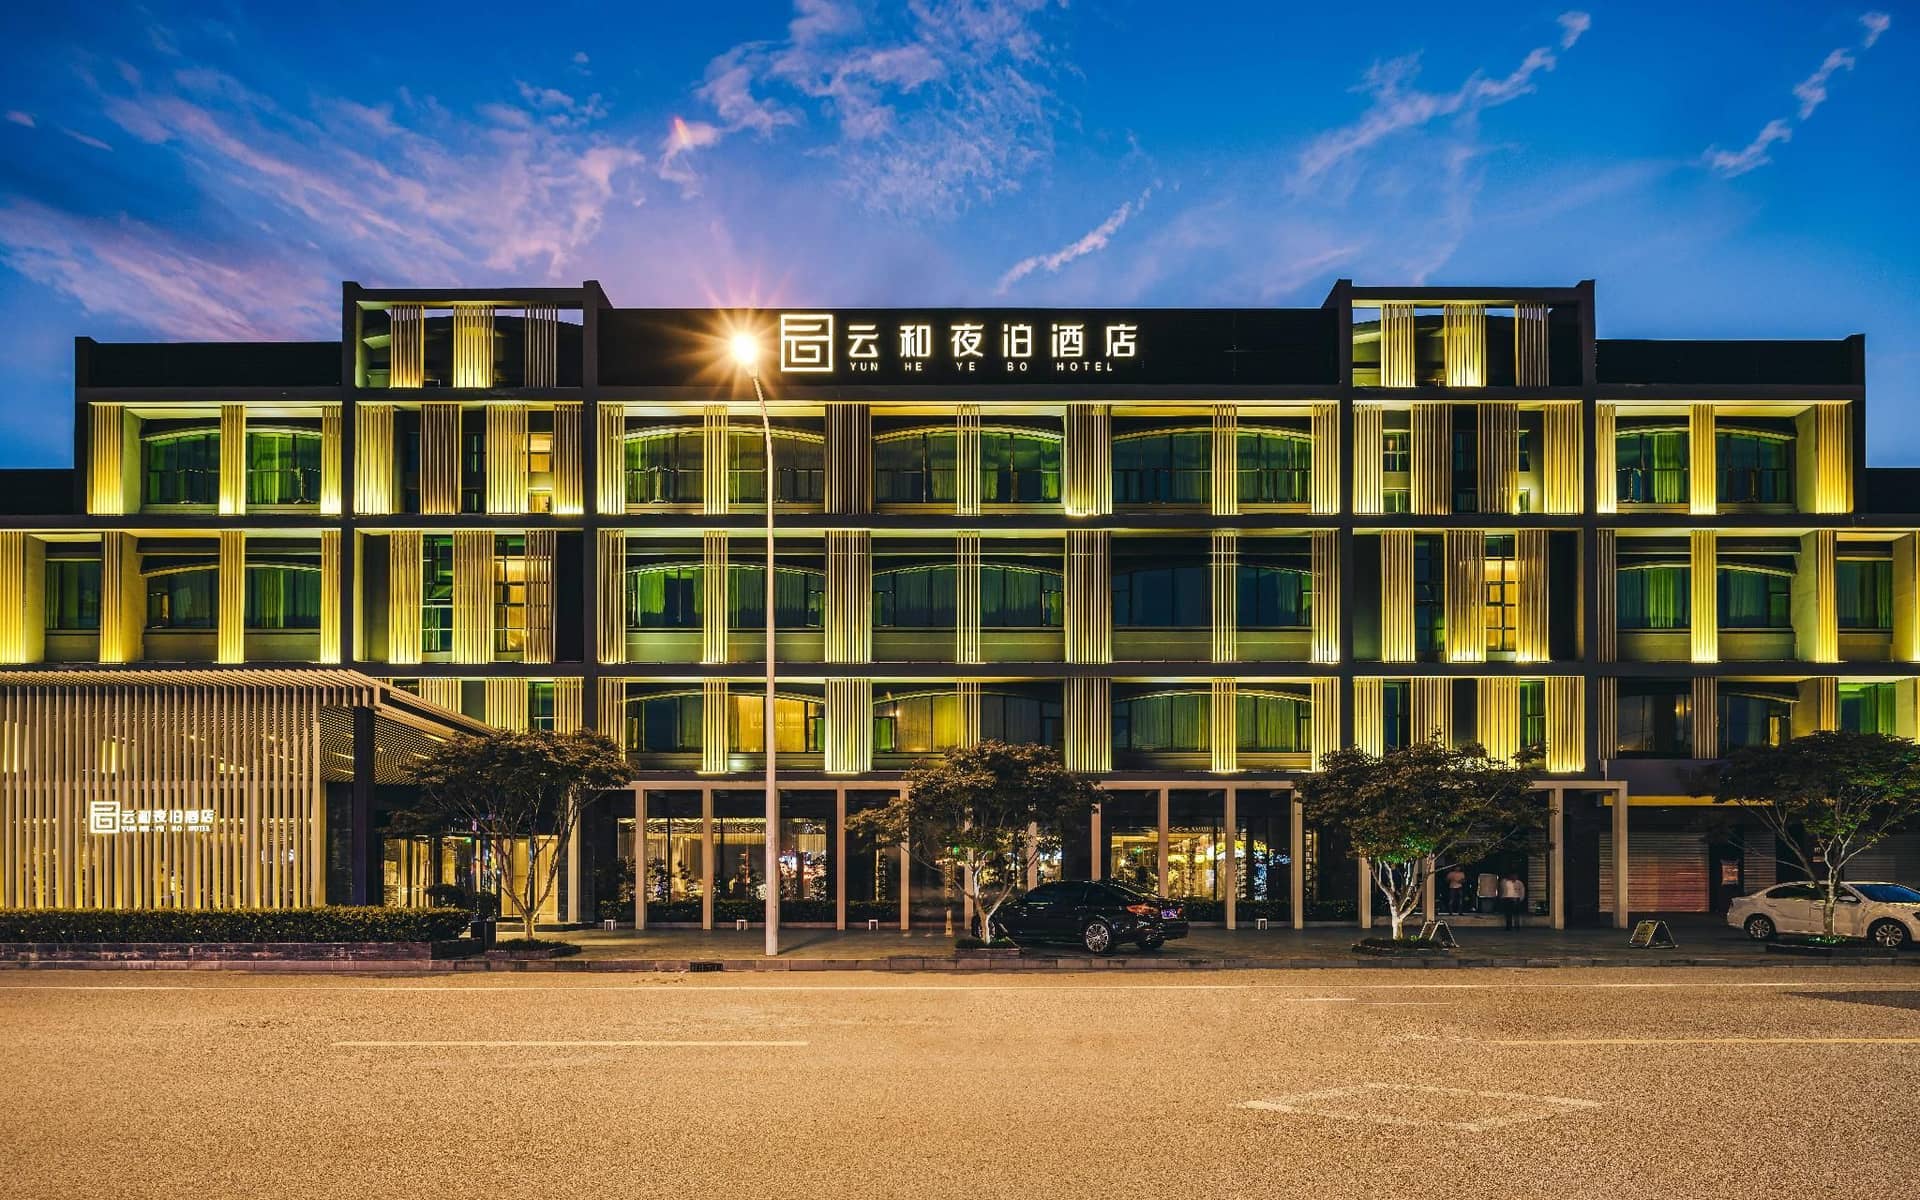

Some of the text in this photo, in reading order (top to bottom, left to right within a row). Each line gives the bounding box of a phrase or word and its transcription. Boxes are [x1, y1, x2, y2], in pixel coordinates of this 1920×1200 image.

[848, 323, 1138, 358] 云和夜泊酒店
[850, 361, 1113, 372] YUN HE YE BO HOTEL
